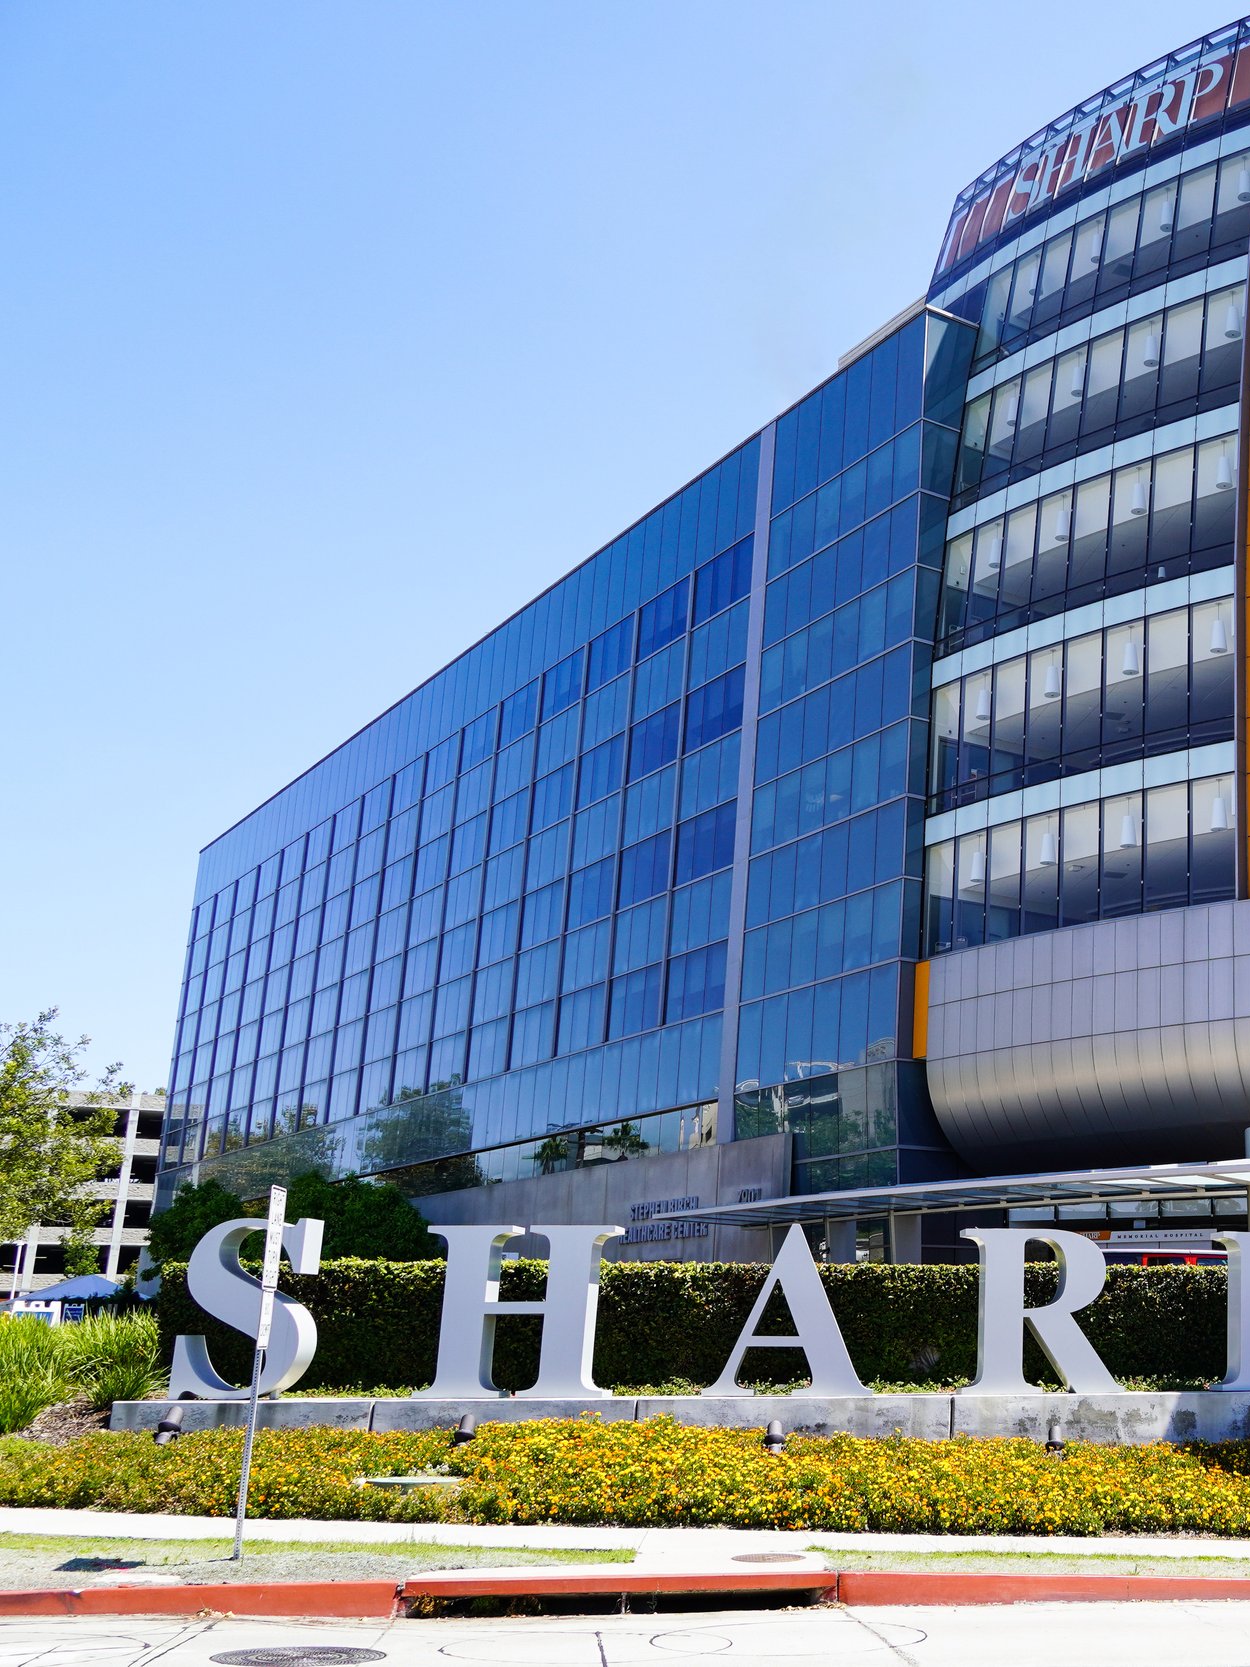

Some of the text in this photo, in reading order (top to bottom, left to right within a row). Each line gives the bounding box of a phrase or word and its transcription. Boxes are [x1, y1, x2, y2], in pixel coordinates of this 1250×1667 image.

[1006, 63, 1224, 222] SHARP
[630, 1196, 699, 1221] STEPHEN BIRCH
[672, 1222, 709, 1239] CENTER
[1083, 1231, 1100, 1239] HARP
